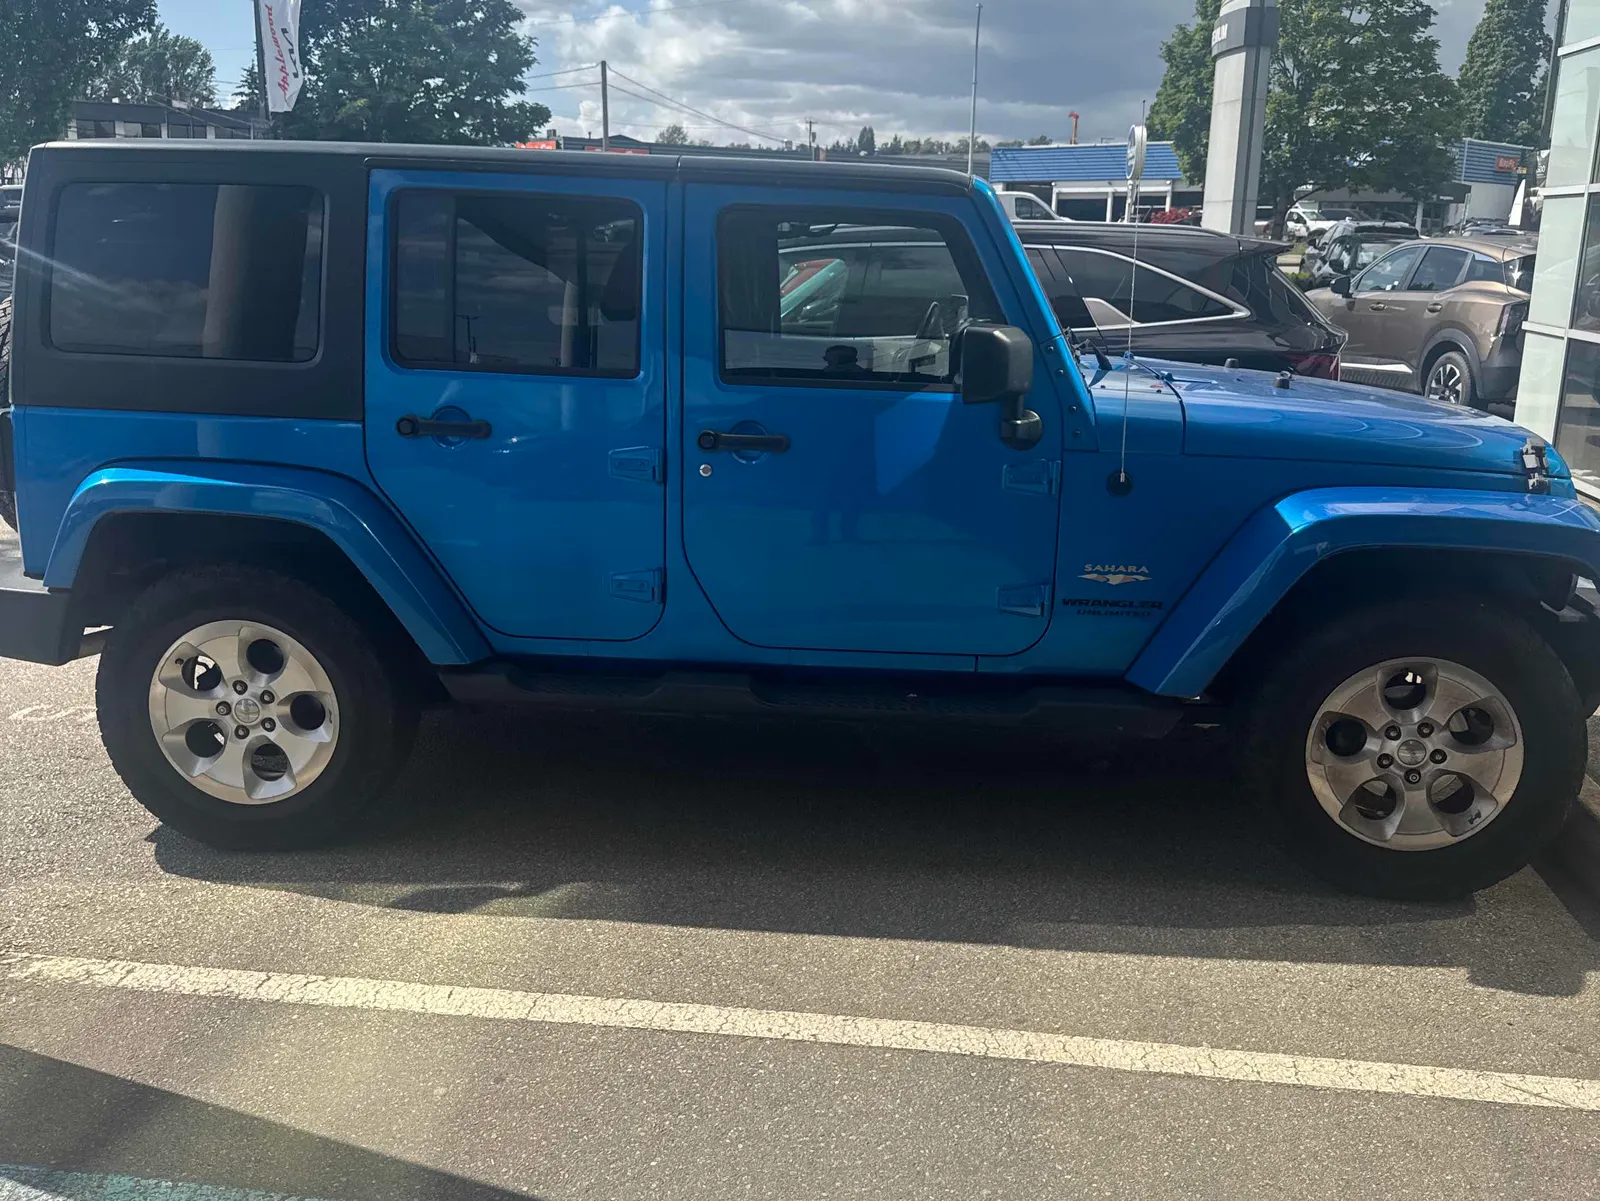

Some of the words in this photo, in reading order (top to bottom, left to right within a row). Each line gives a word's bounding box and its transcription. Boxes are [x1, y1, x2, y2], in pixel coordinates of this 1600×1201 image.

[264, 3, 289, 93] Applewood
[1084, 563, 1149, 573] SAHARA
[1062, 598, 1163, 609] WRANGLER
[1077, 609, 1151, 617] UNLIMITED
